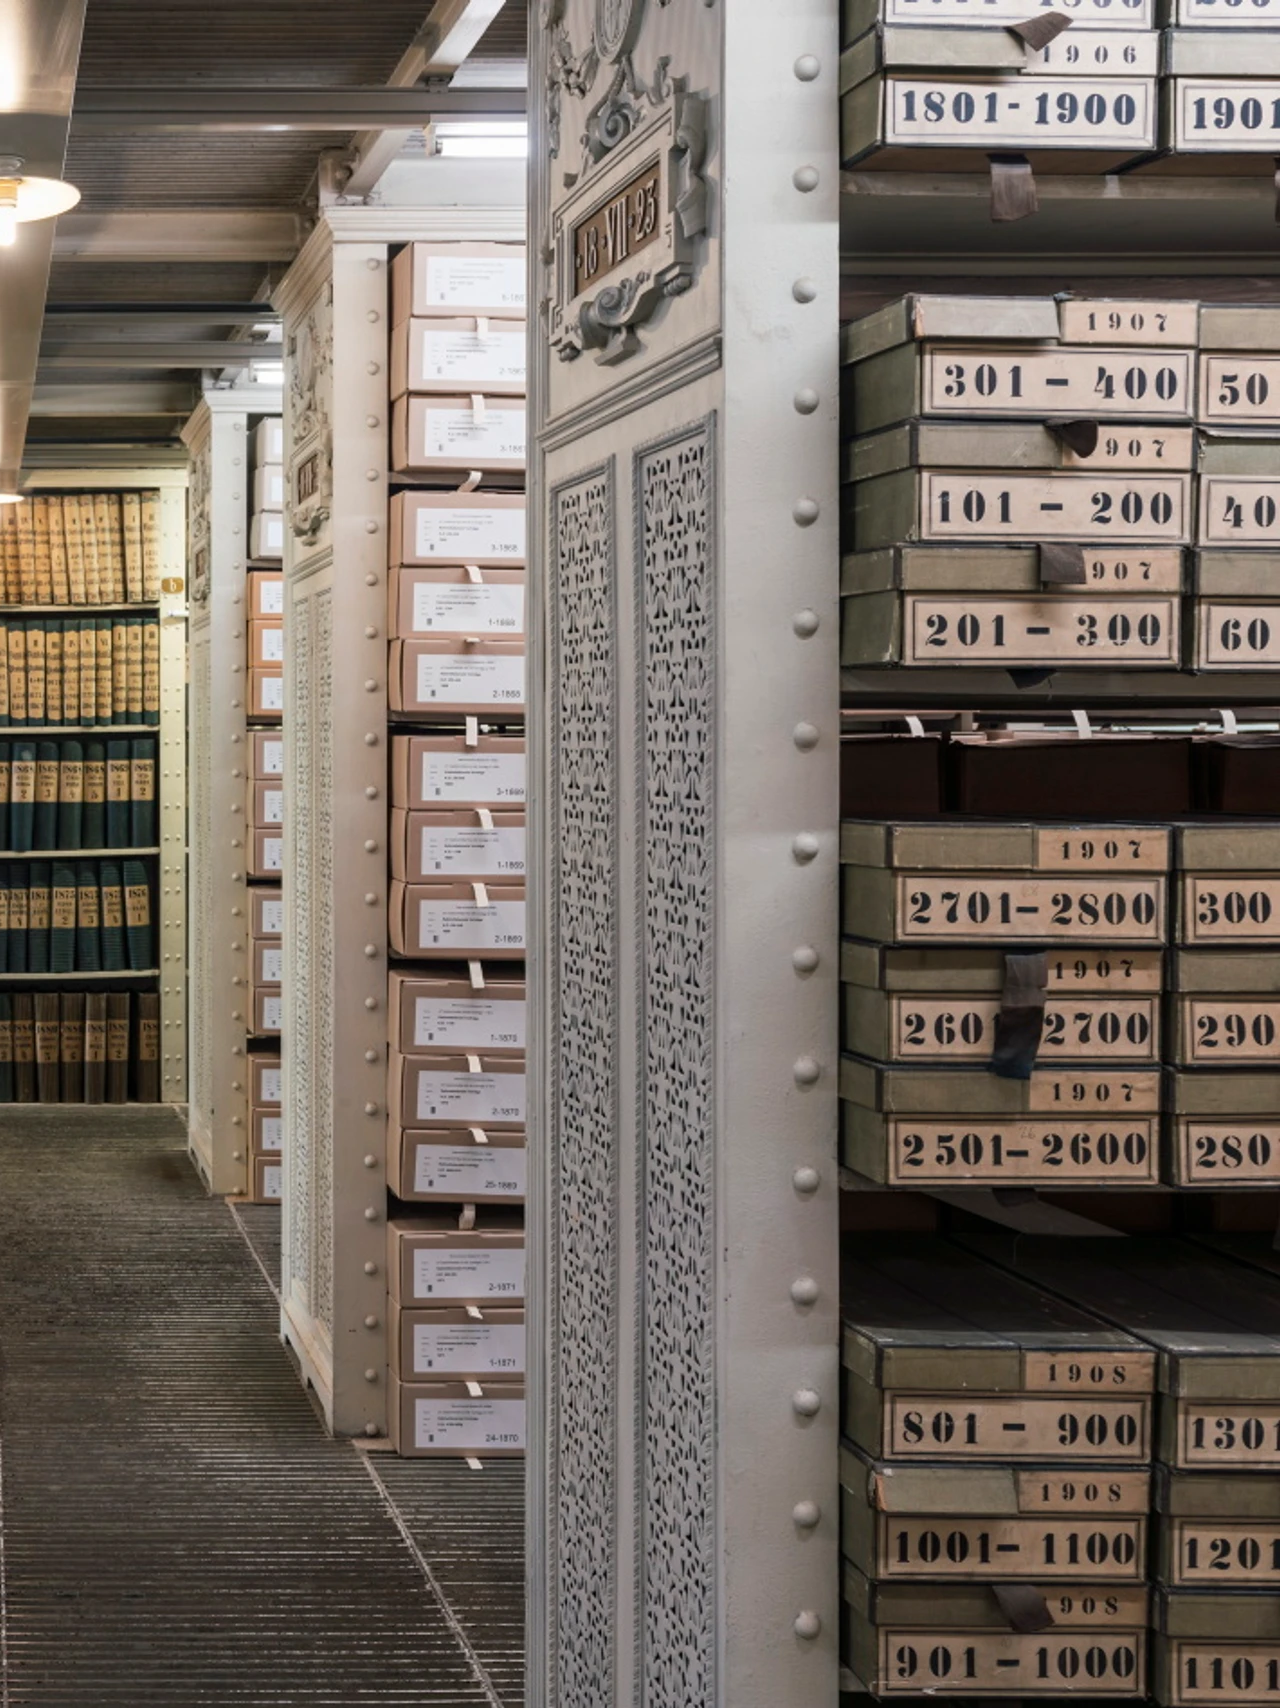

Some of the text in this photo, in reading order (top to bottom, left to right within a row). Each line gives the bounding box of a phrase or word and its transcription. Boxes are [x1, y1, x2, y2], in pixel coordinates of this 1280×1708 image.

[1038, 43, 1135, 63] 1906
[1089, 313, 1165, 332] 1907
[1063, 842, 1139, 859] 1907
[1052, 956, 1138, 979] 1907
[1054, 1083, 1132, 1101] 1907
